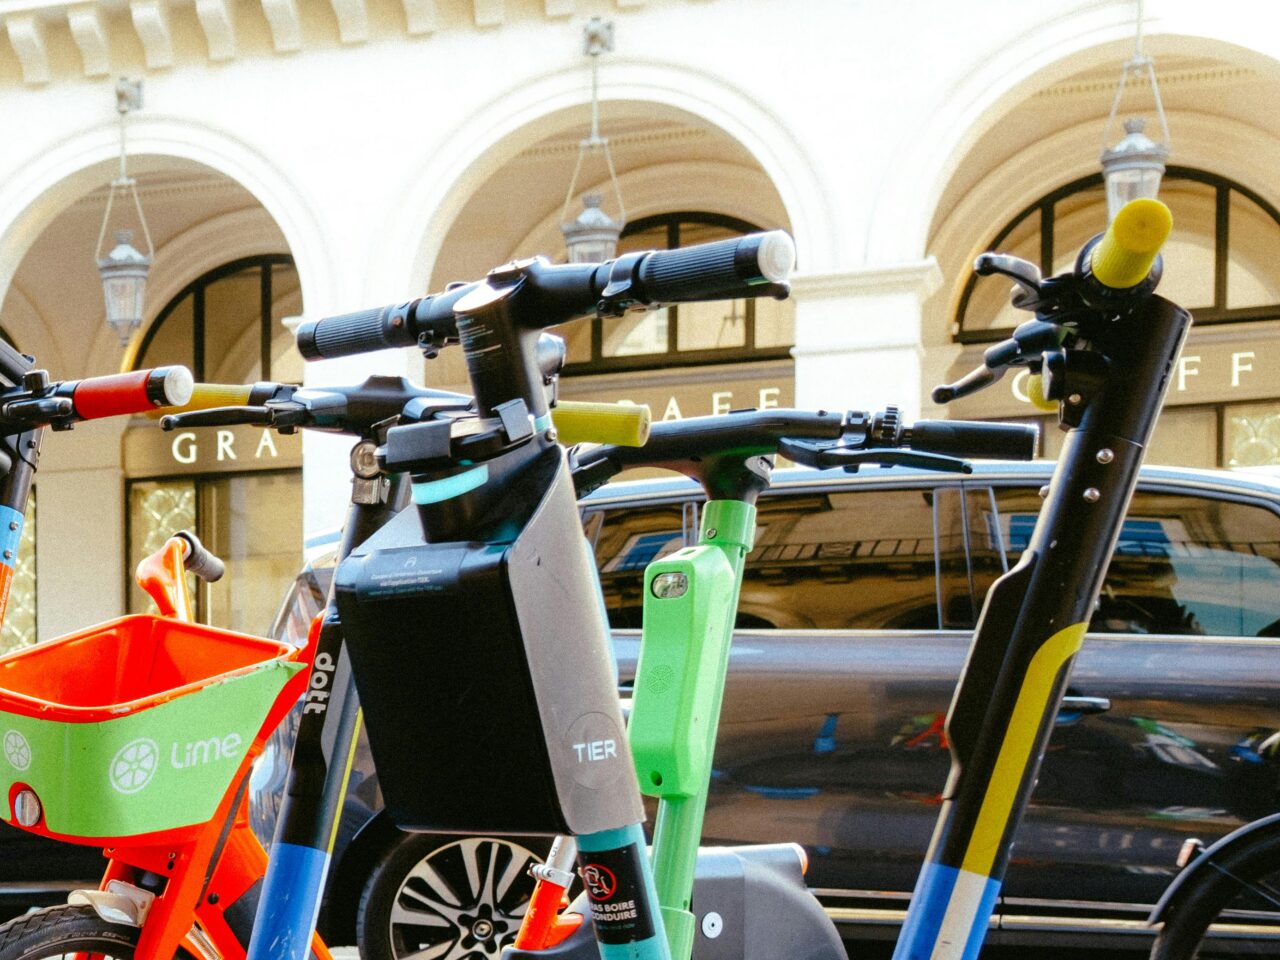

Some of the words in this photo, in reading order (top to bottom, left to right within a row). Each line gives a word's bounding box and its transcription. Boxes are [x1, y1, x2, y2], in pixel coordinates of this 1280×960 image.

[172, 429, 278, 463] GRA
[304, 652, 335, 714] dott
[171, 733, 242, 769] Lime
[573, 739, 617, 763] TIER
[605, 900, 636, 912] BOIRE
